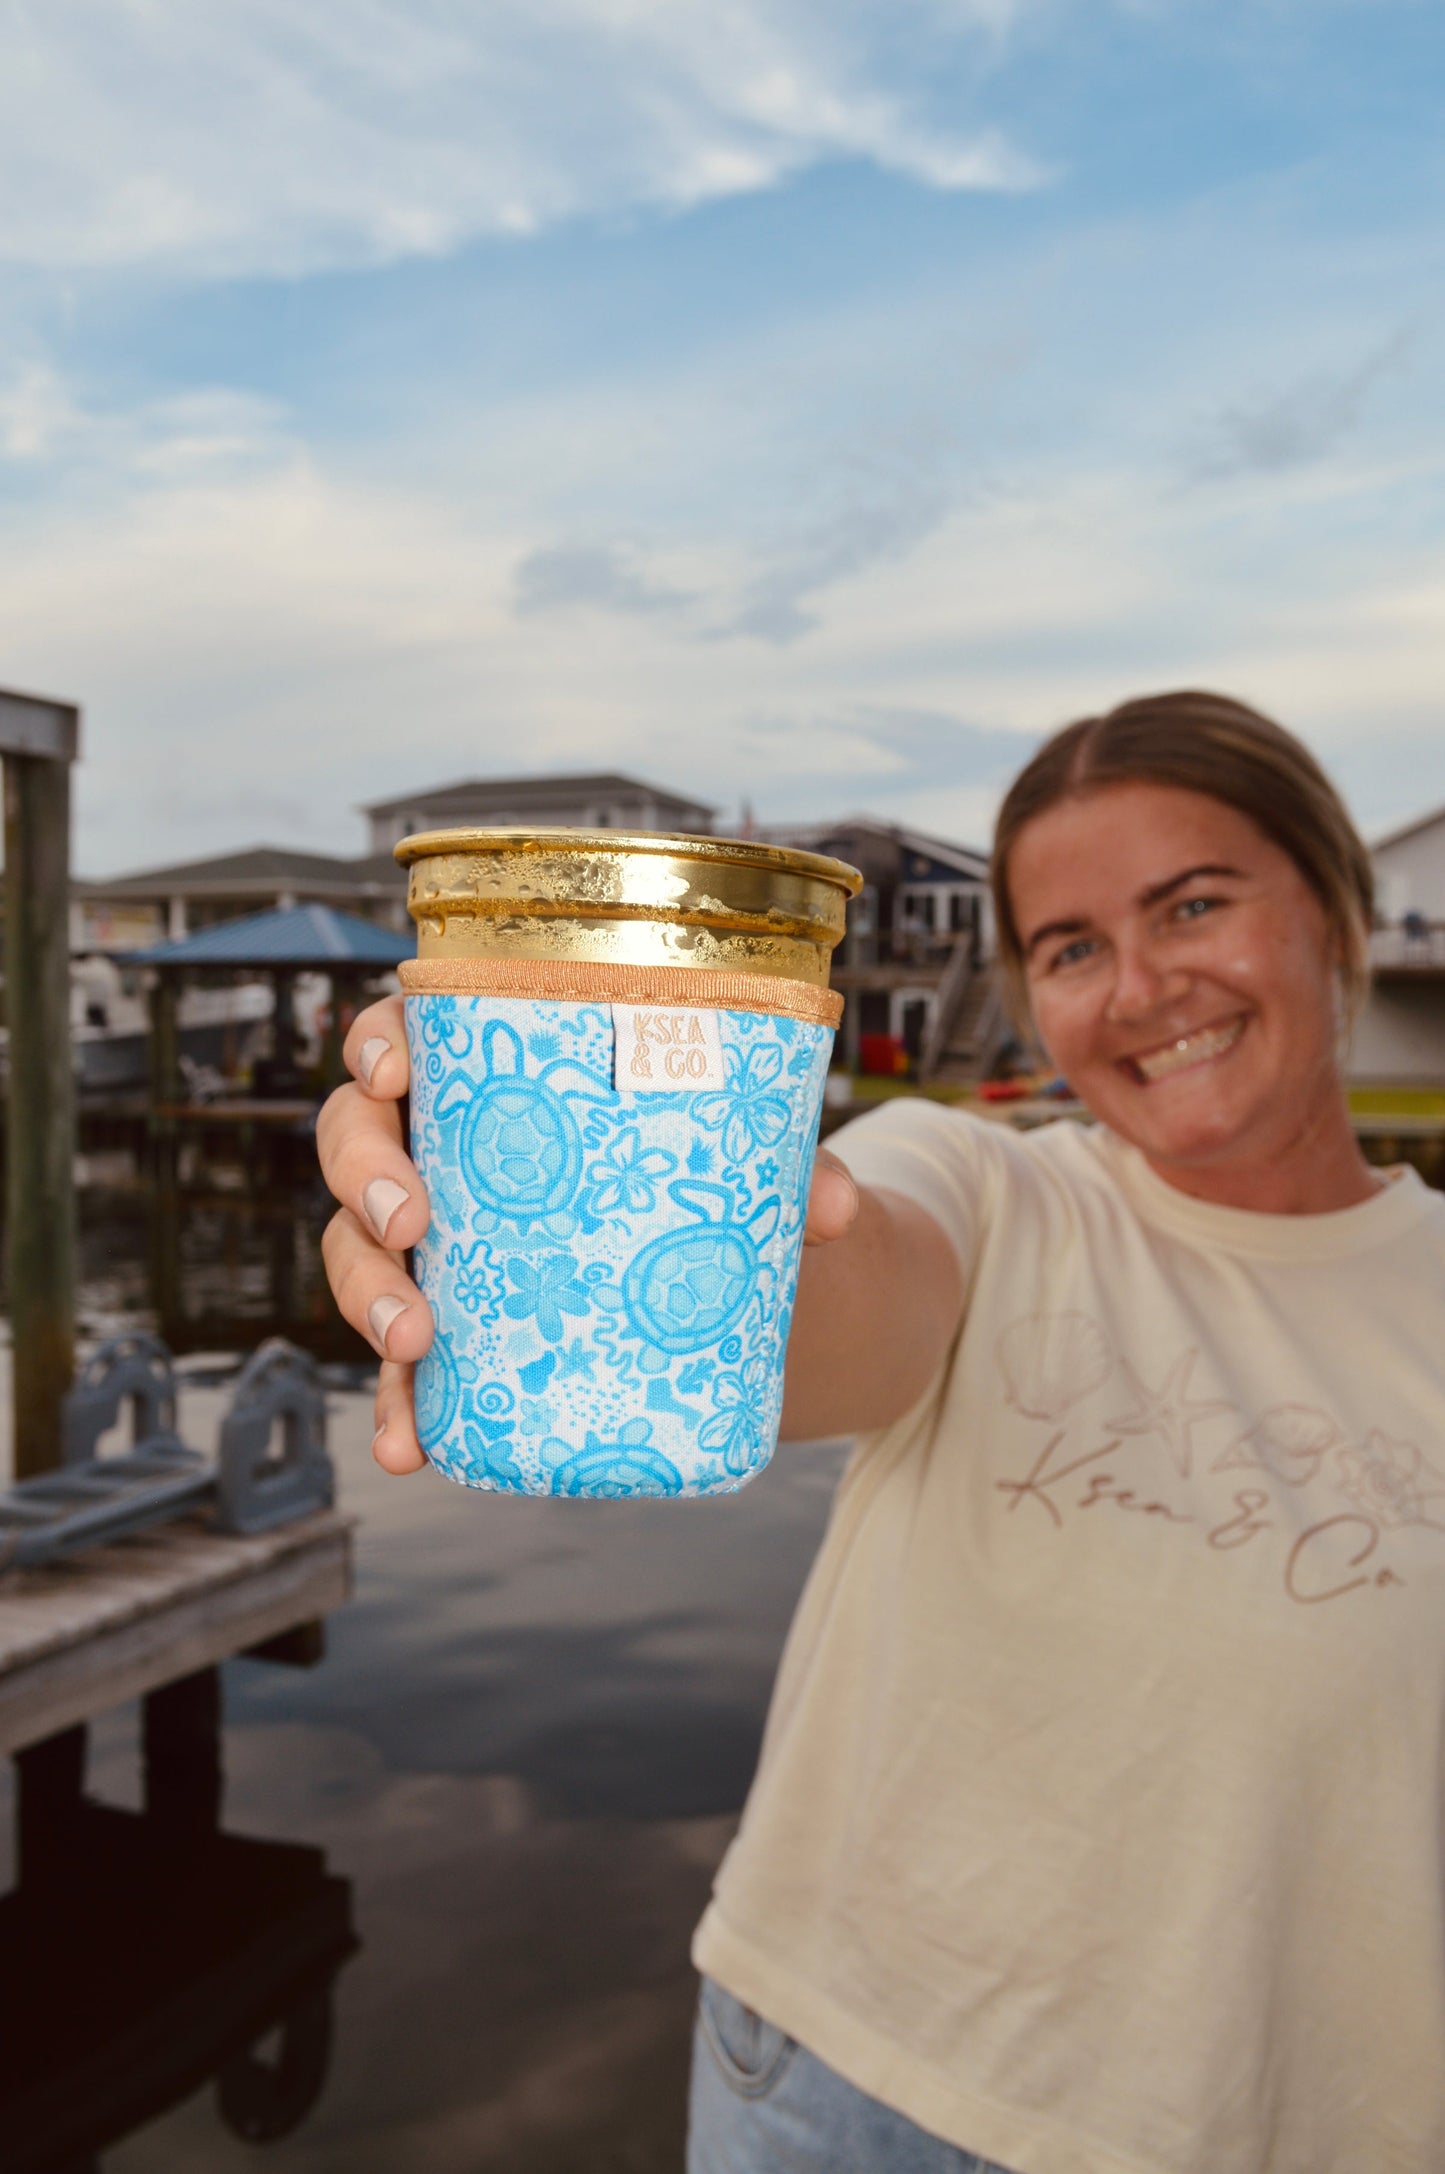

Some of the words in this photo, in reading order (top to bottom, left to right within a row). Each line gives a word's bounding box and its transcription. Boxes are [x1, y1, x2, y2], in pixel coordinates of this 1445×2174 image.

[634, 1012, 706, 1044] KSEA
[631, 1043, 653, 1079] &
[995, 1430, 1194, 1529] Ksea
[1207, 1488, 1272, 1550] &
[1284, 1513, 1404, 1604] Co
